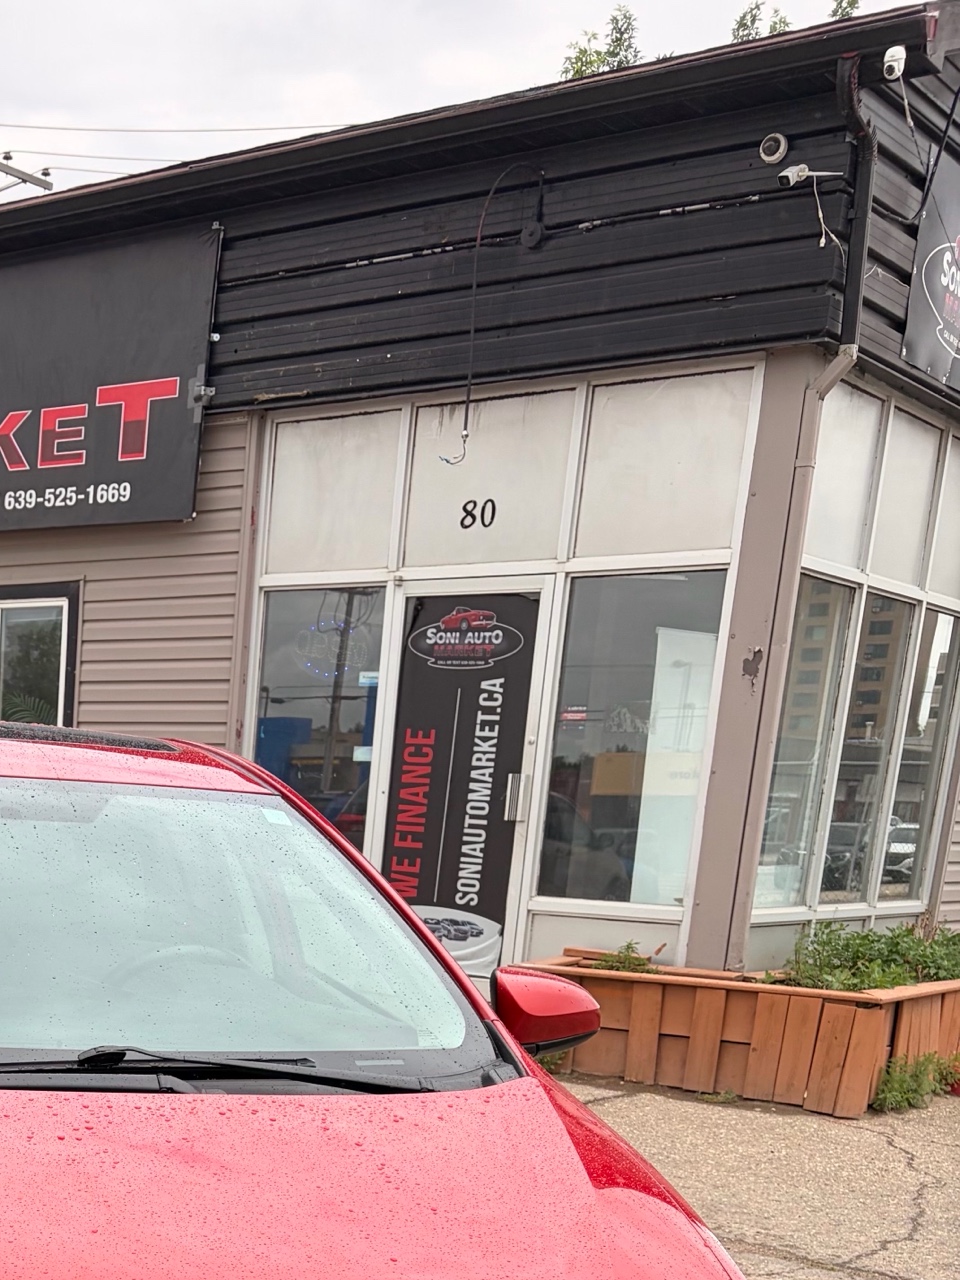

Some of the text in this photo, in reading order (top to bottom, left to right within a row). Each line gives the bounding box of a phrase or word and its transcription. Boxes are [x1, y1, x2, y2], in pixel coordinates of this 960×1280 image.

[3, 481, 132, 510] 639-525-1669
[460, 498, 496, 530] 80
[426, 628, 503, 644] SONI AUTO
[455, 677, 506, 907] SONIAUTOMARKET.CA
[389, 728, 436, 898] WE FINANCE
